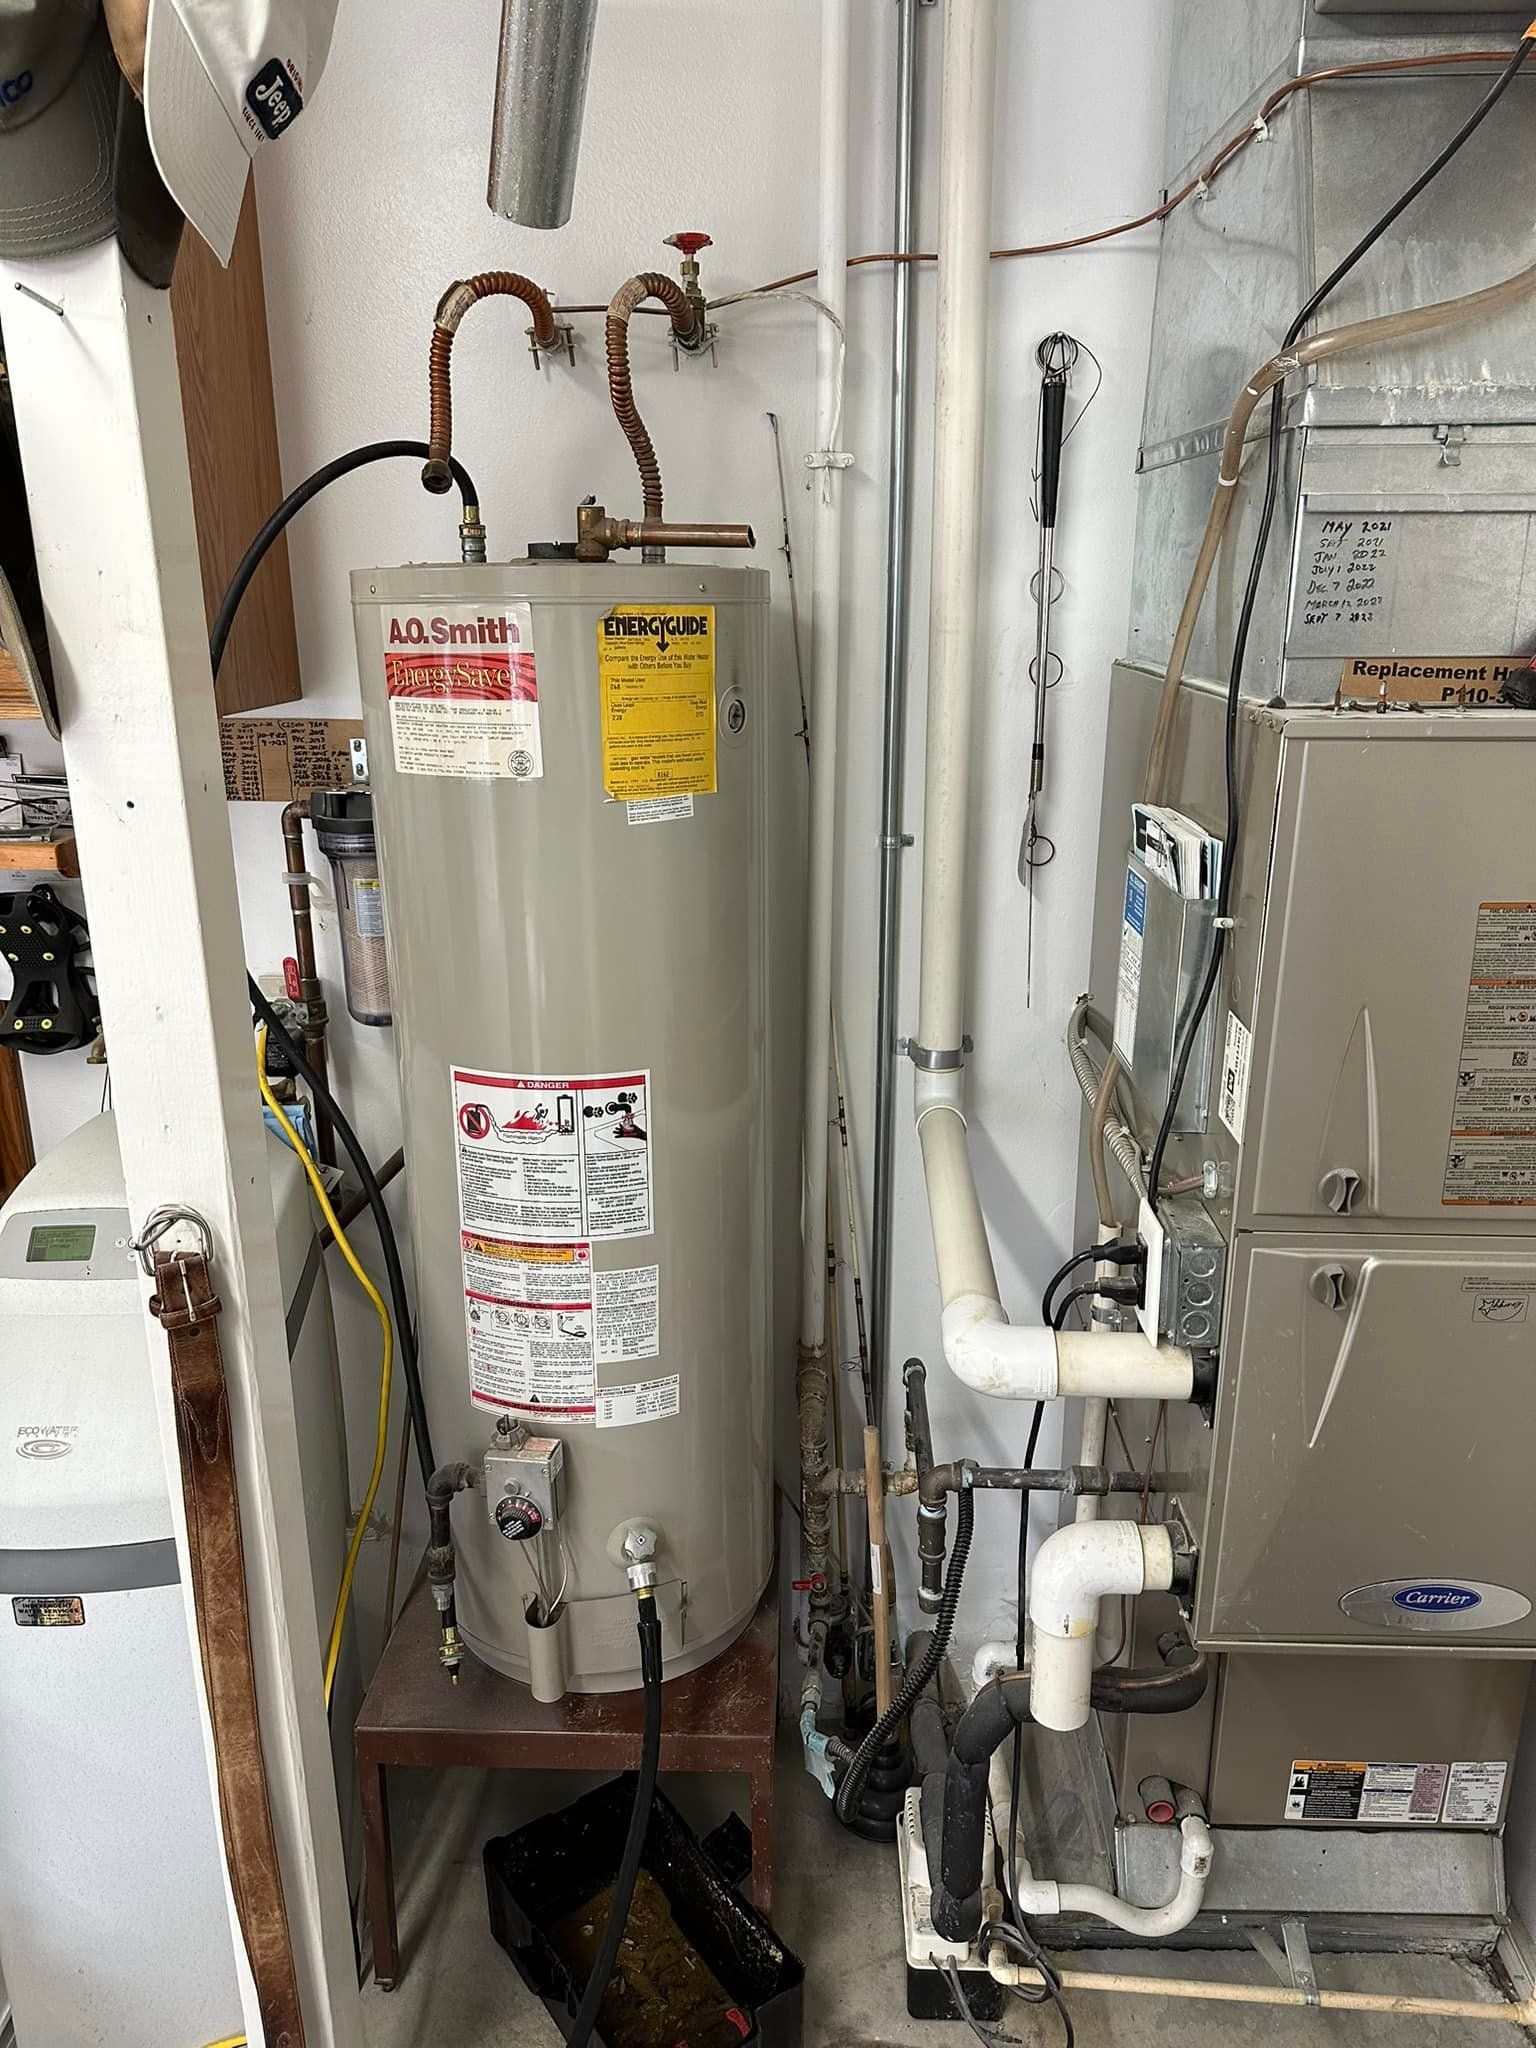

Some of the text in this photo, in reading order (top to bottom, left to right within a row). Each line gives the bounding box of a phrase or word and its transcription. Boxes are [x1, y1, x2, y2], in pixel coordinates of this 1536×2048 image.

[255, 74, 292, 128] Jeep
[1322, 521, 1392, 540] MAY 2021
[1357, 538, 1384, 547] 2021
[1352, 549, 1387, 560] 2022
[1332, 581, 1340, 591] 7
[604, 616, 708, 637] ENERGYGUIDE
[1352, 660, 1487, 681] Replacement
[527, 1081, 570, 1089] DANGER
[1406, 1591, 1470, 1605] Carrier
